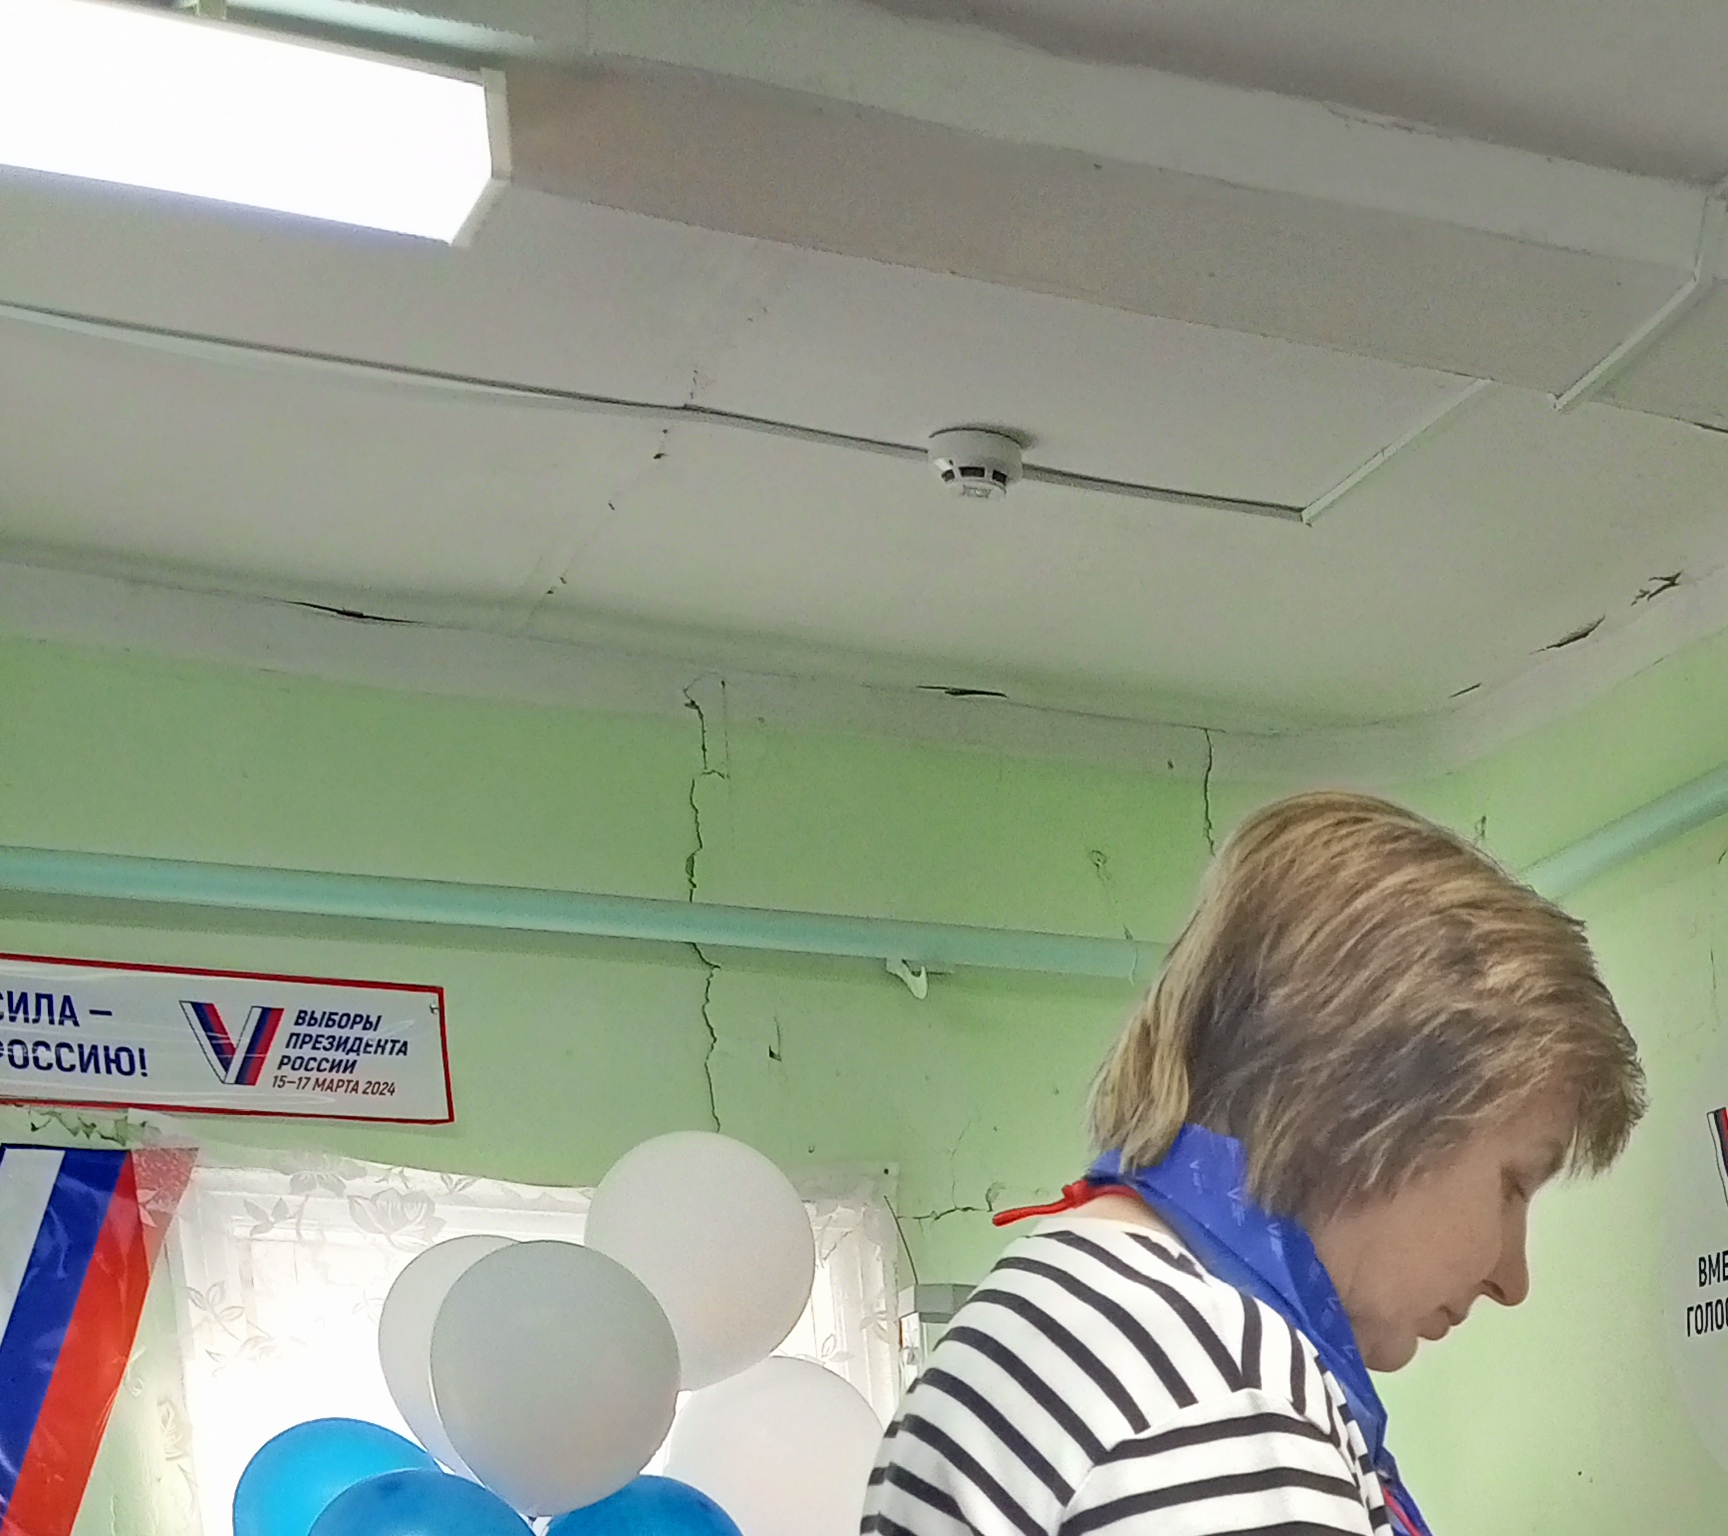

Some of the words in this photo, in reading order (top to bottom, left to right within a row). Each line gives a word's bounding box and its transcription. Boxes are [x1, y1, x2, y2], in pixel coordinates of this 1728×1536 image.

[0, 990, 80, 1028] ИЛА
[293, 1009, 383, 1032] ВЫБОРЫ
[284, 1032, 409, 1057] ПРЕЗИДЕНТА
[0, 1038, 148, 1077] ОССИЮ!
[276, 1054, 358, 1075] РОССИИ
[312, 1077, 360, 1095] МАРТА
[361, 1080, 397, 1097] 2024
